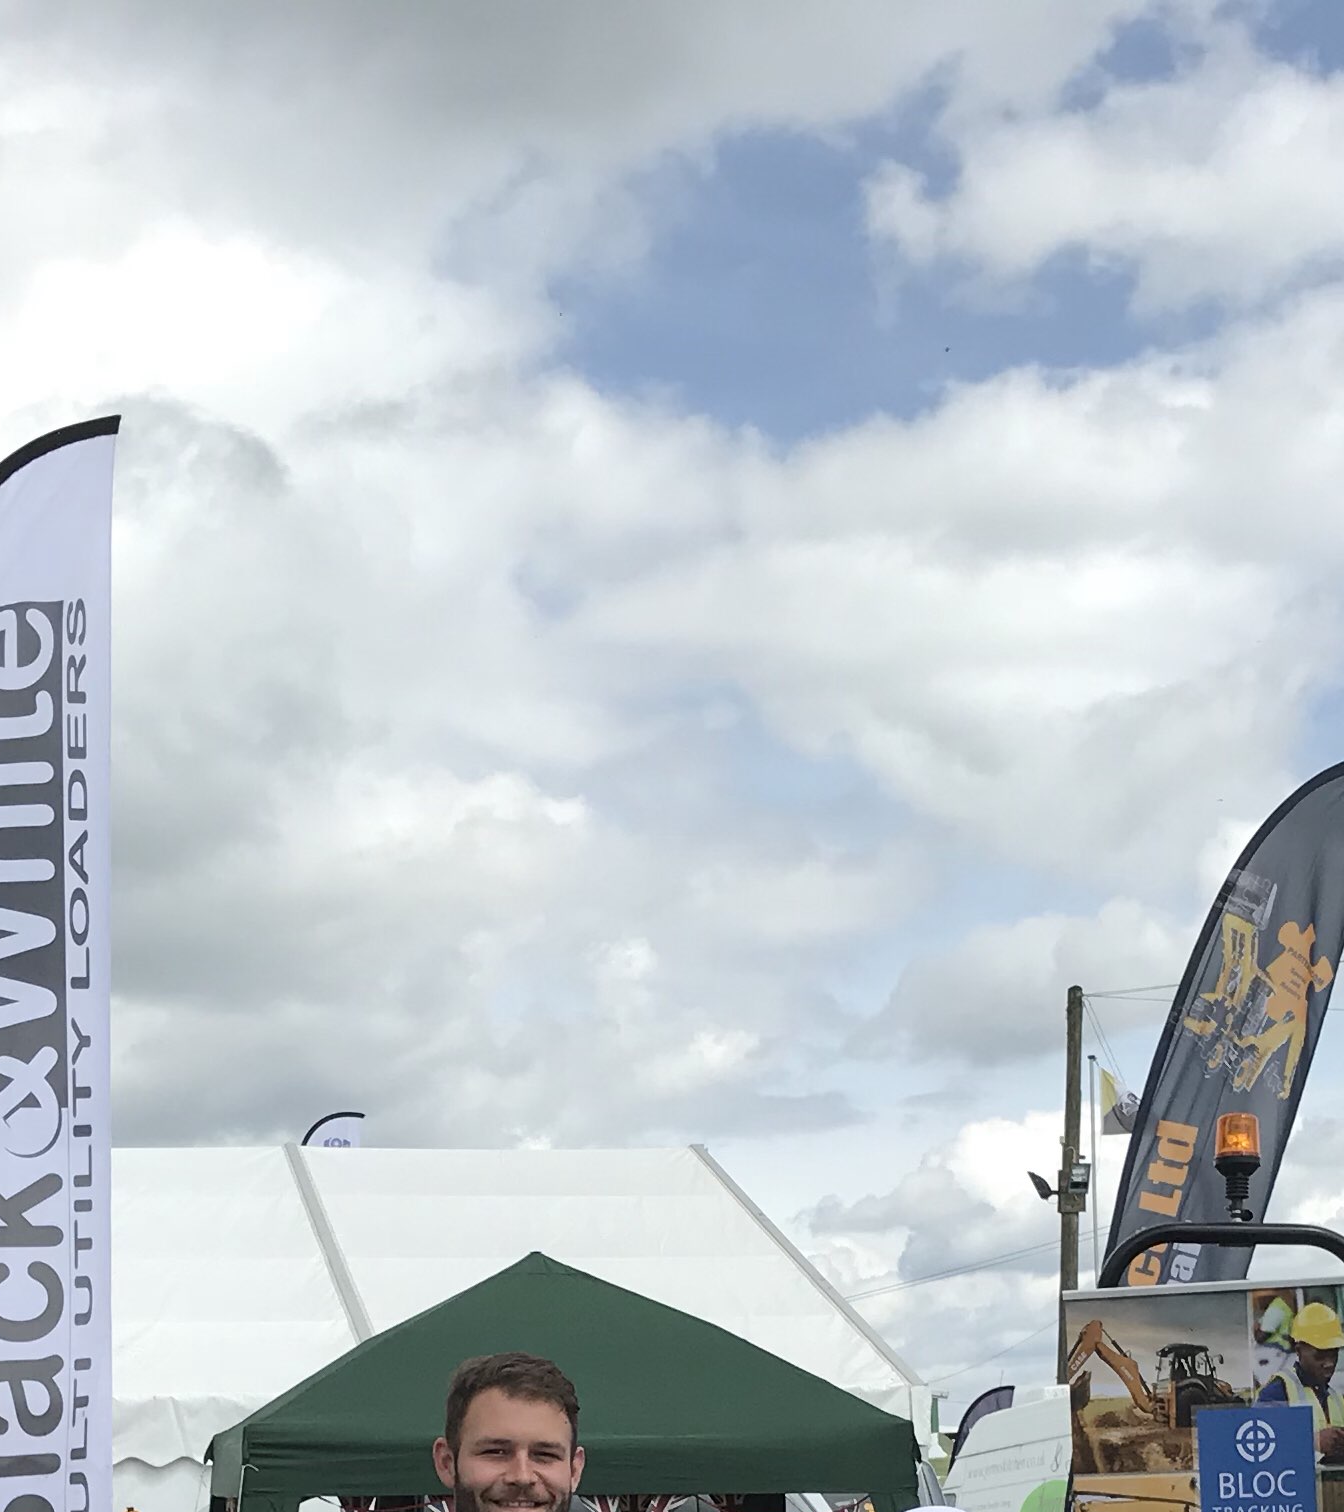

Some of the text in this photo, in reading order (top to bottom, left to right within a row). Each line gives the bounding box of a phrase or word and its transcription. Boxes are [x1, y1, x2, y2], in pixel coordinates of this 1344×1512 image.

[65, 599, 88, 981] LOADERS
[68, 1032, 98, 1318] UTILITY
[1138, 1119, 1199, 1217] Ltd
[1219, 1470, 1297, 1499] BLOC
